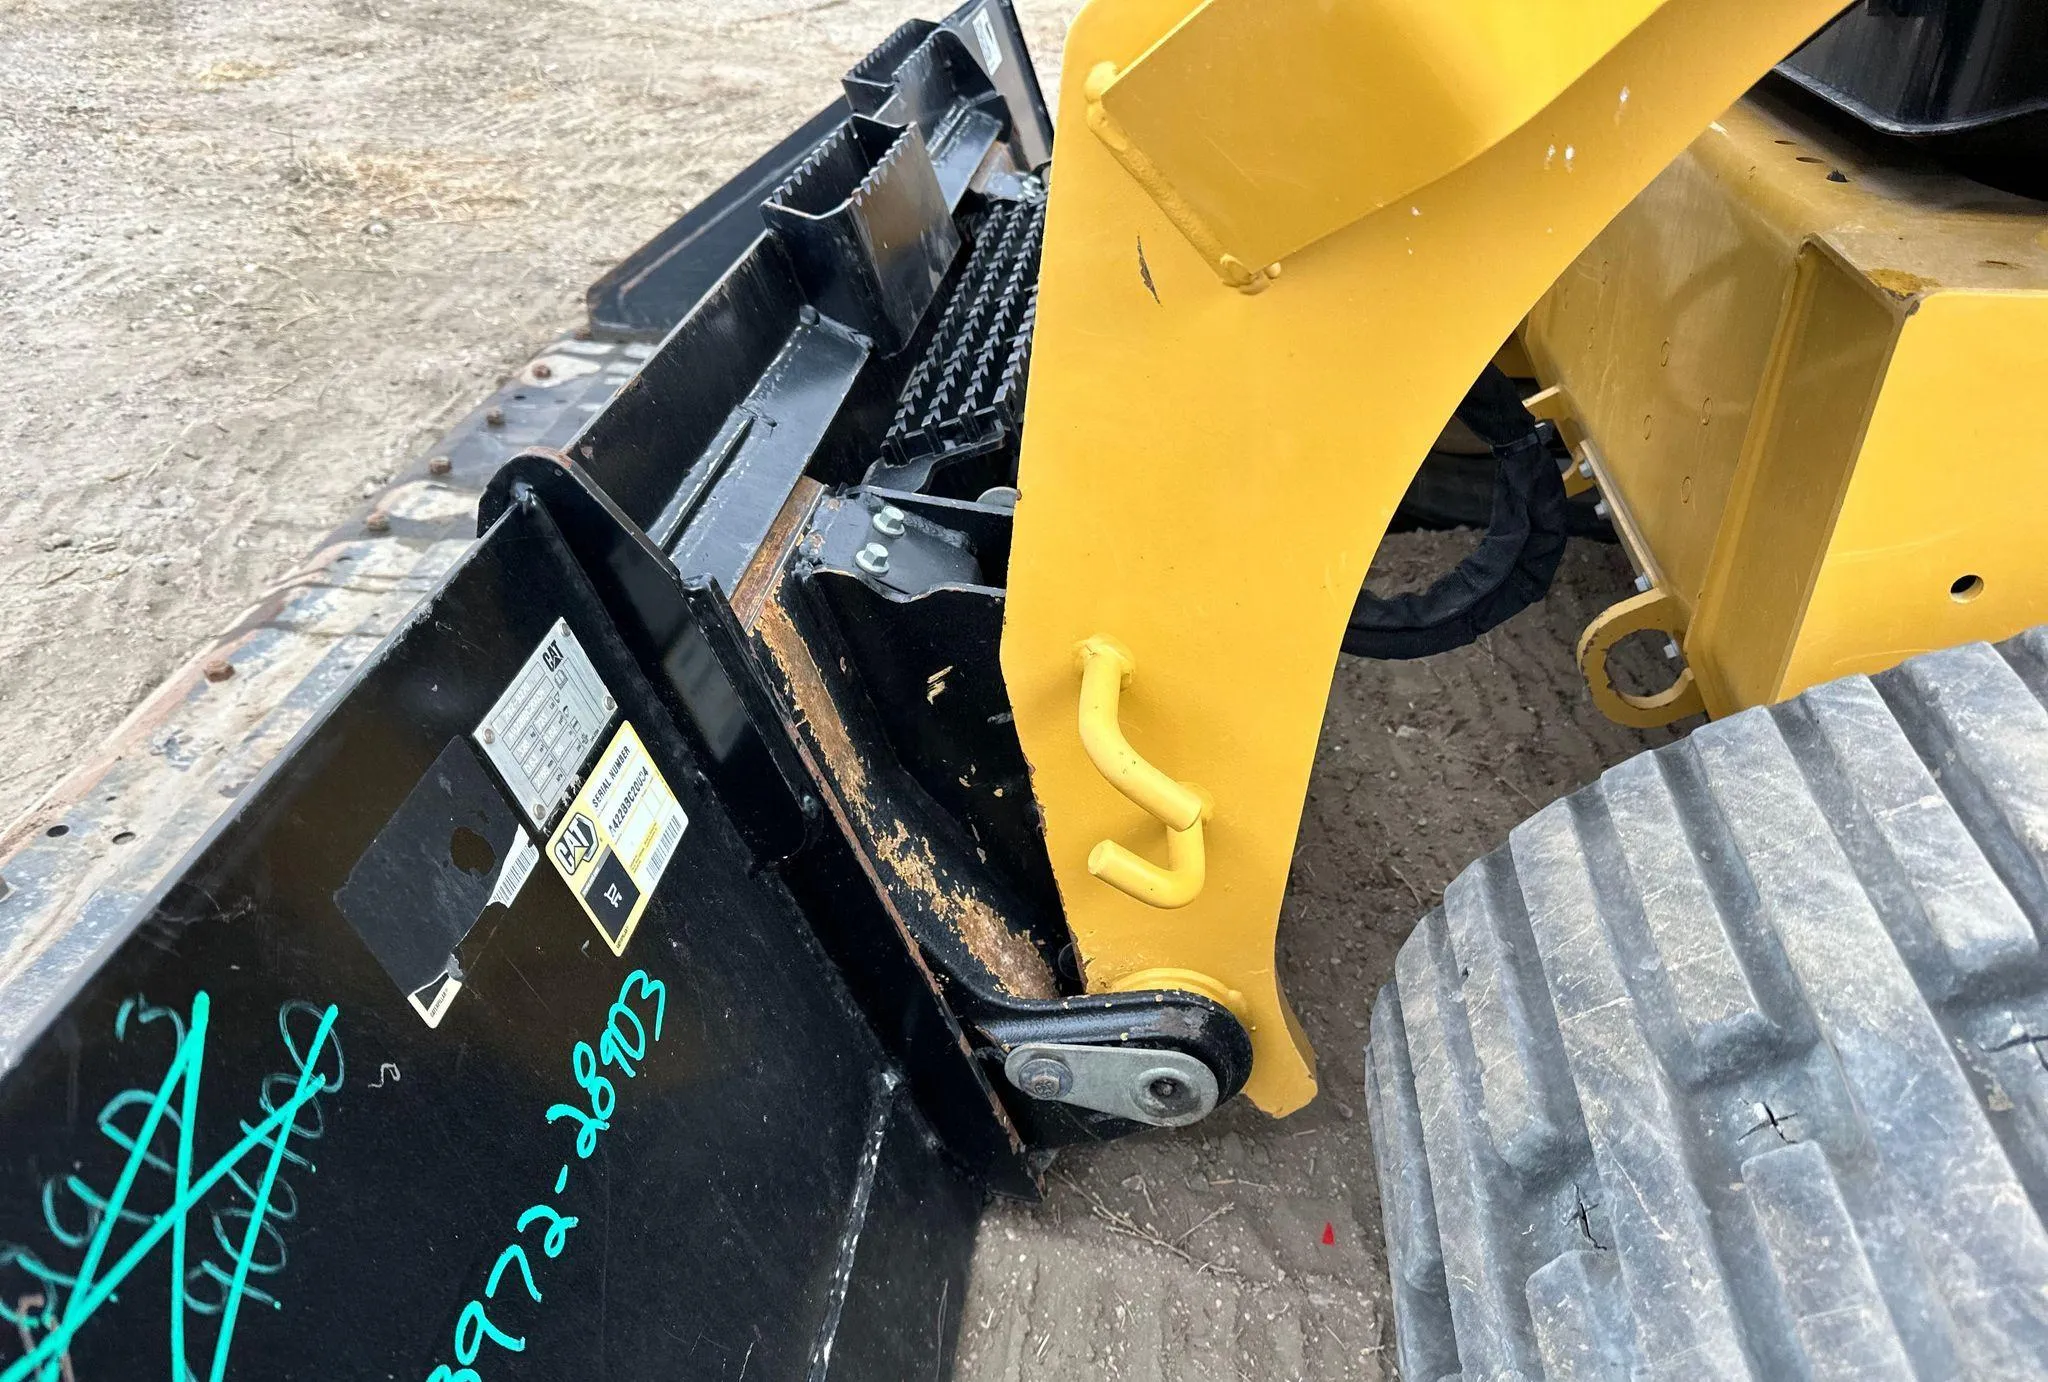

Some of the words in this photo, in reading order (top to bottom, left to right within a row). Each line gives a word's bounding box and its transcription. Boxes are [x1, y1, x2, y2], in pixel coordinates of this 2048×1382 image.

[541, 639, 565, 673] CAT
[590, 775, 612, 809] SERIAL
[607, 743, 631, 781] NUMBER
[555, 815, 591, 875] CAT
[427, 990, 448, 1017] CATERPILLAR
